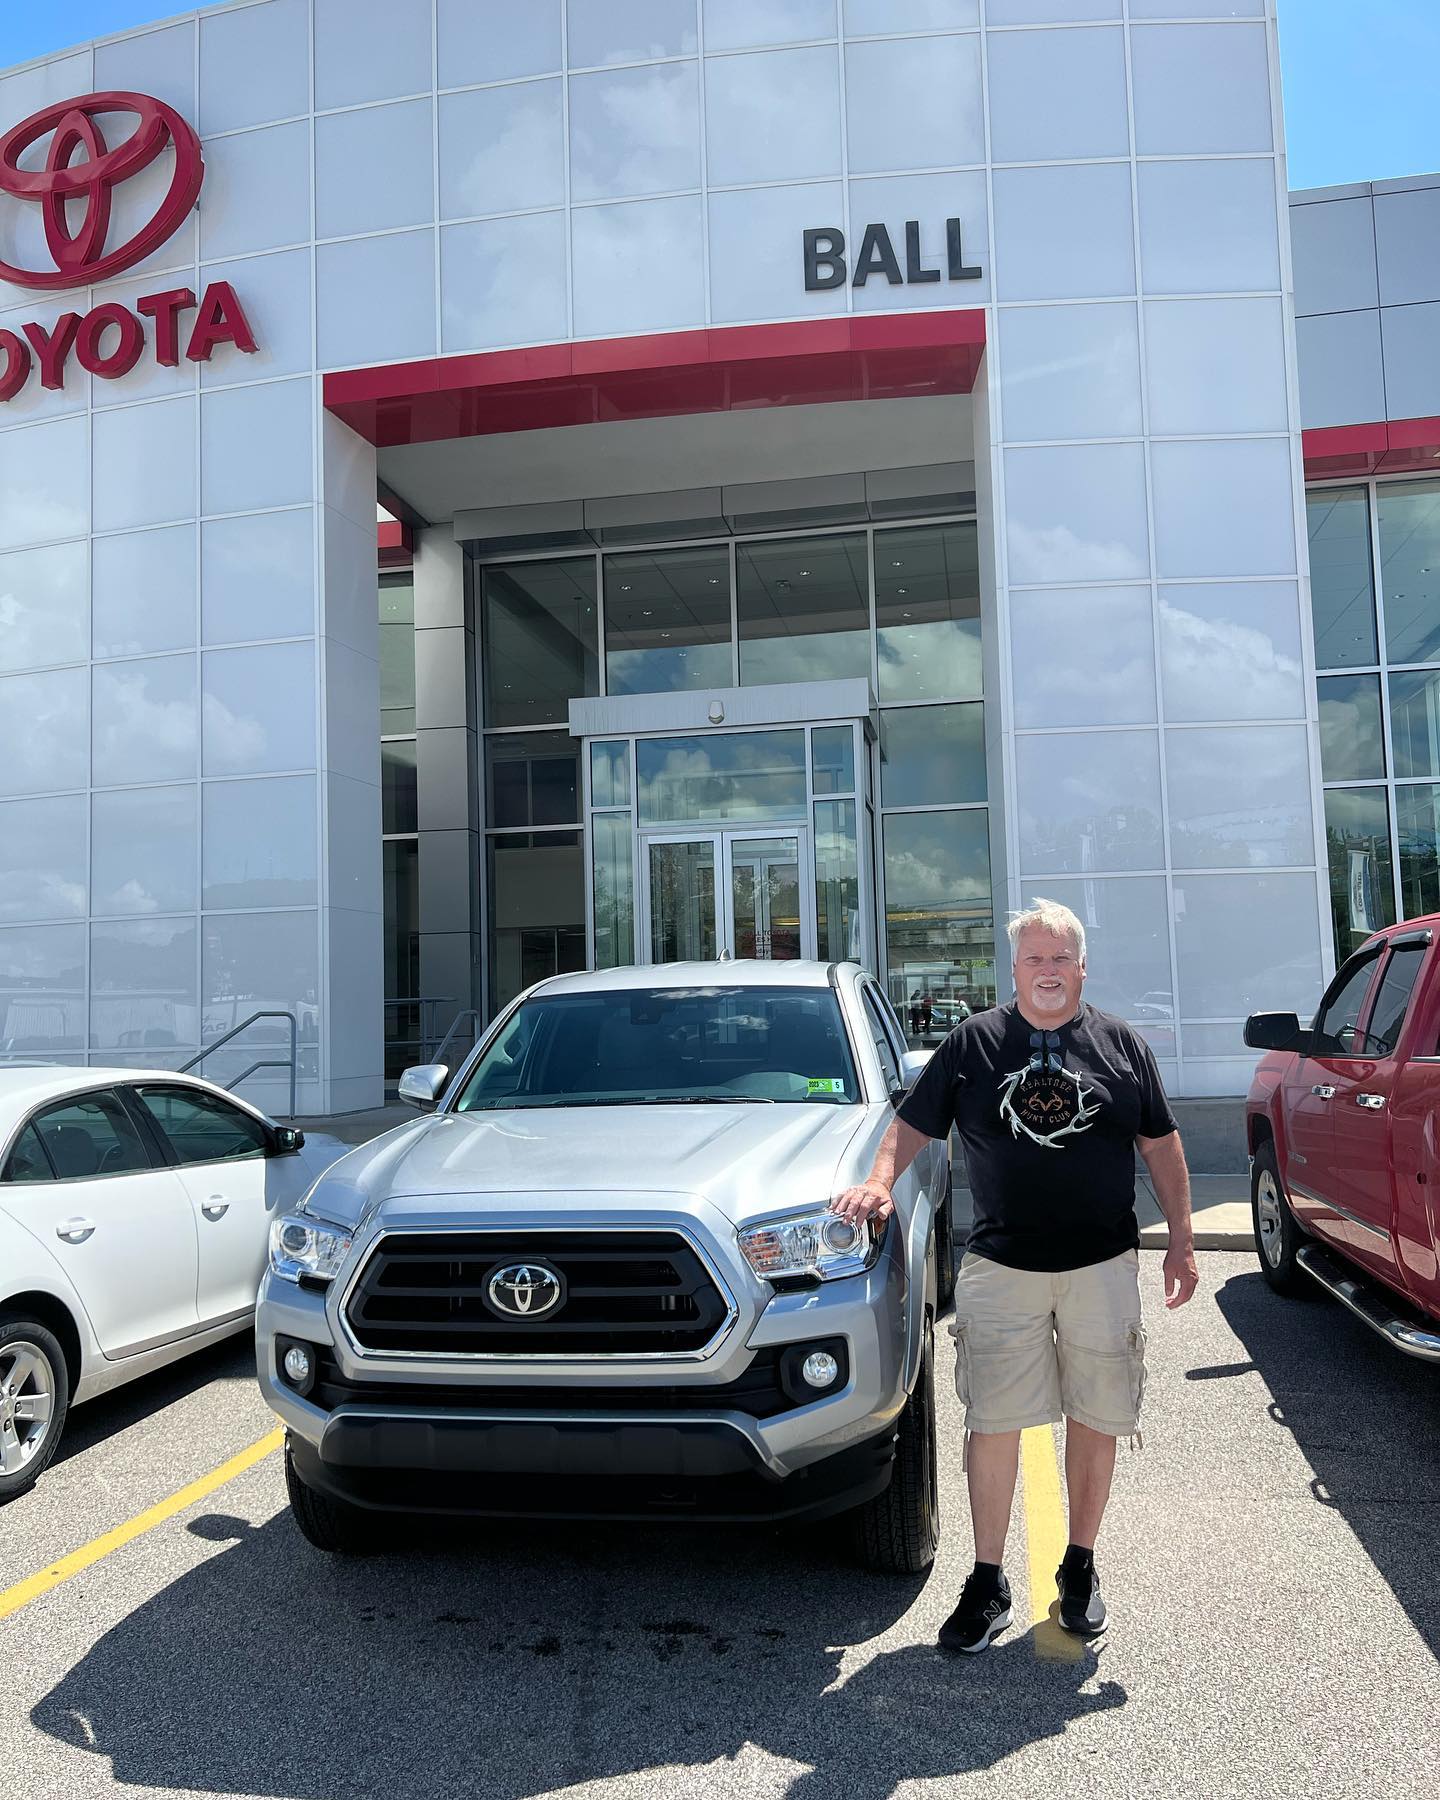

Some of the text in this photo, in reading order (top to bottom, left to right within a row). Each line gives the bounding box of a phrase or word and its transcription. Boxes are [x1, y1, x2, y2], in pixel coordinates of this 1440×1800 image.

[803, 217, 982, 291] BALL
[835, 1081, 840, 1089] 5
[1020, 1077, 1072, 1092] REALTREE
[1020, 1109, 1071, 1124] HUNT CLUB
